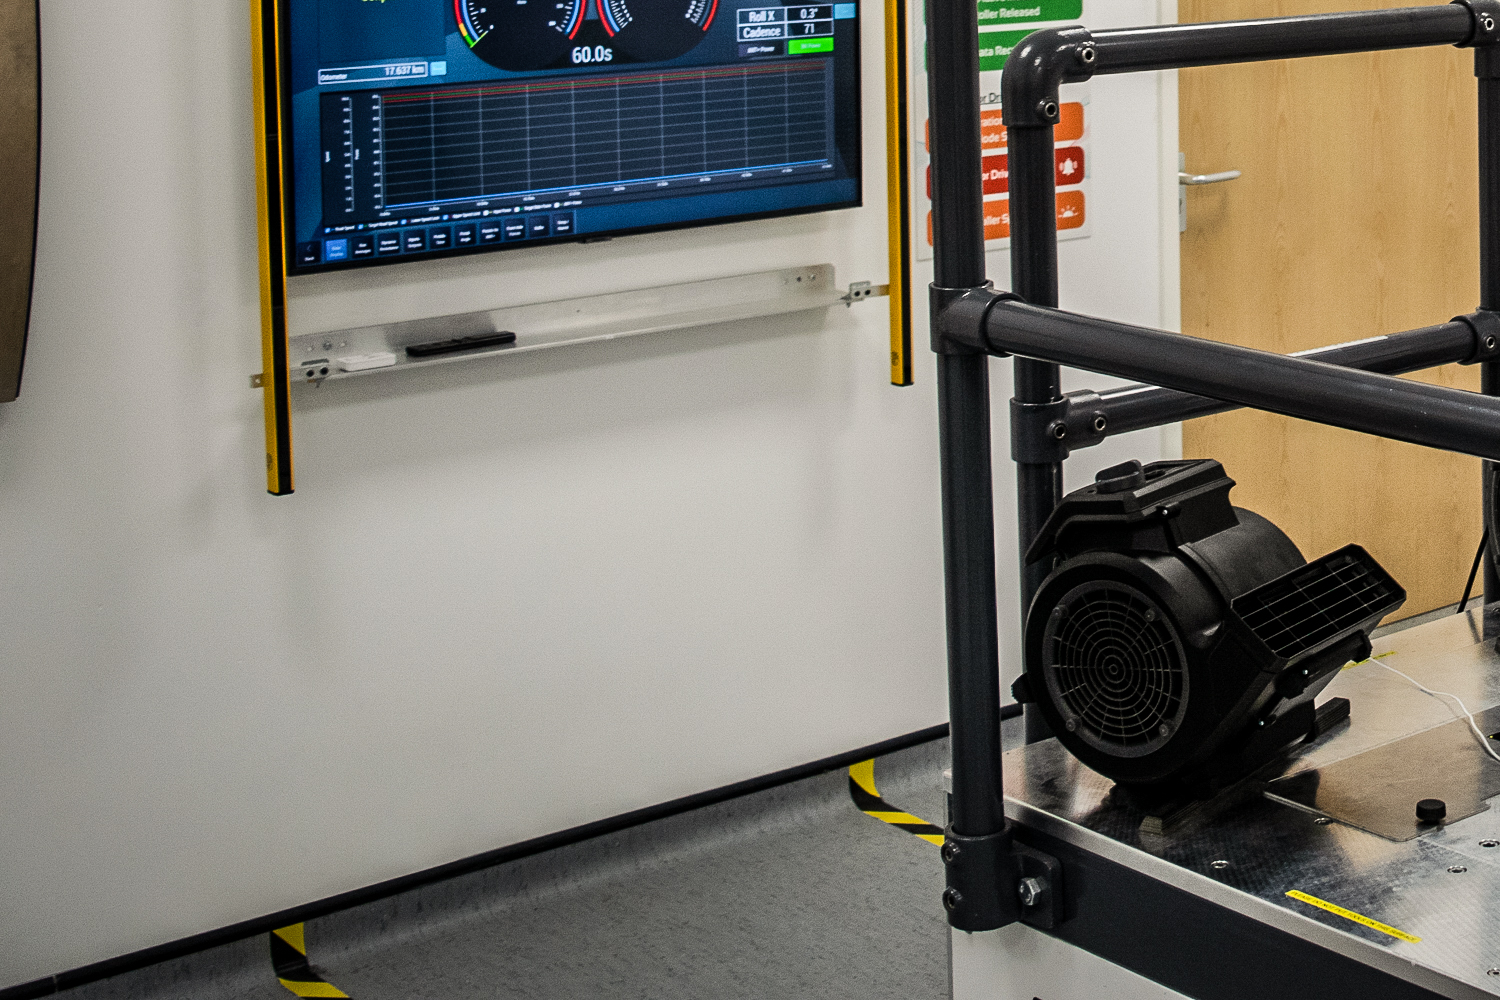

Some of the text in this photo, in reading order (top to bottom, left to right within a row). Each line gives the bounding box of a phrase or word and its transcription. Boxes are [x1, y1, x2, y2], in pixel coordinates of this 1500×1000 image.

[748, 11, 767, 22] Roll
[768, 10, 775, 21] X
[978, 6, 1041, 20] oller Released
[743, 23, 815, 38] Cadence 71
[572, 45, 613, 64] 60.0s
[979, 48, 994, 57] ata
